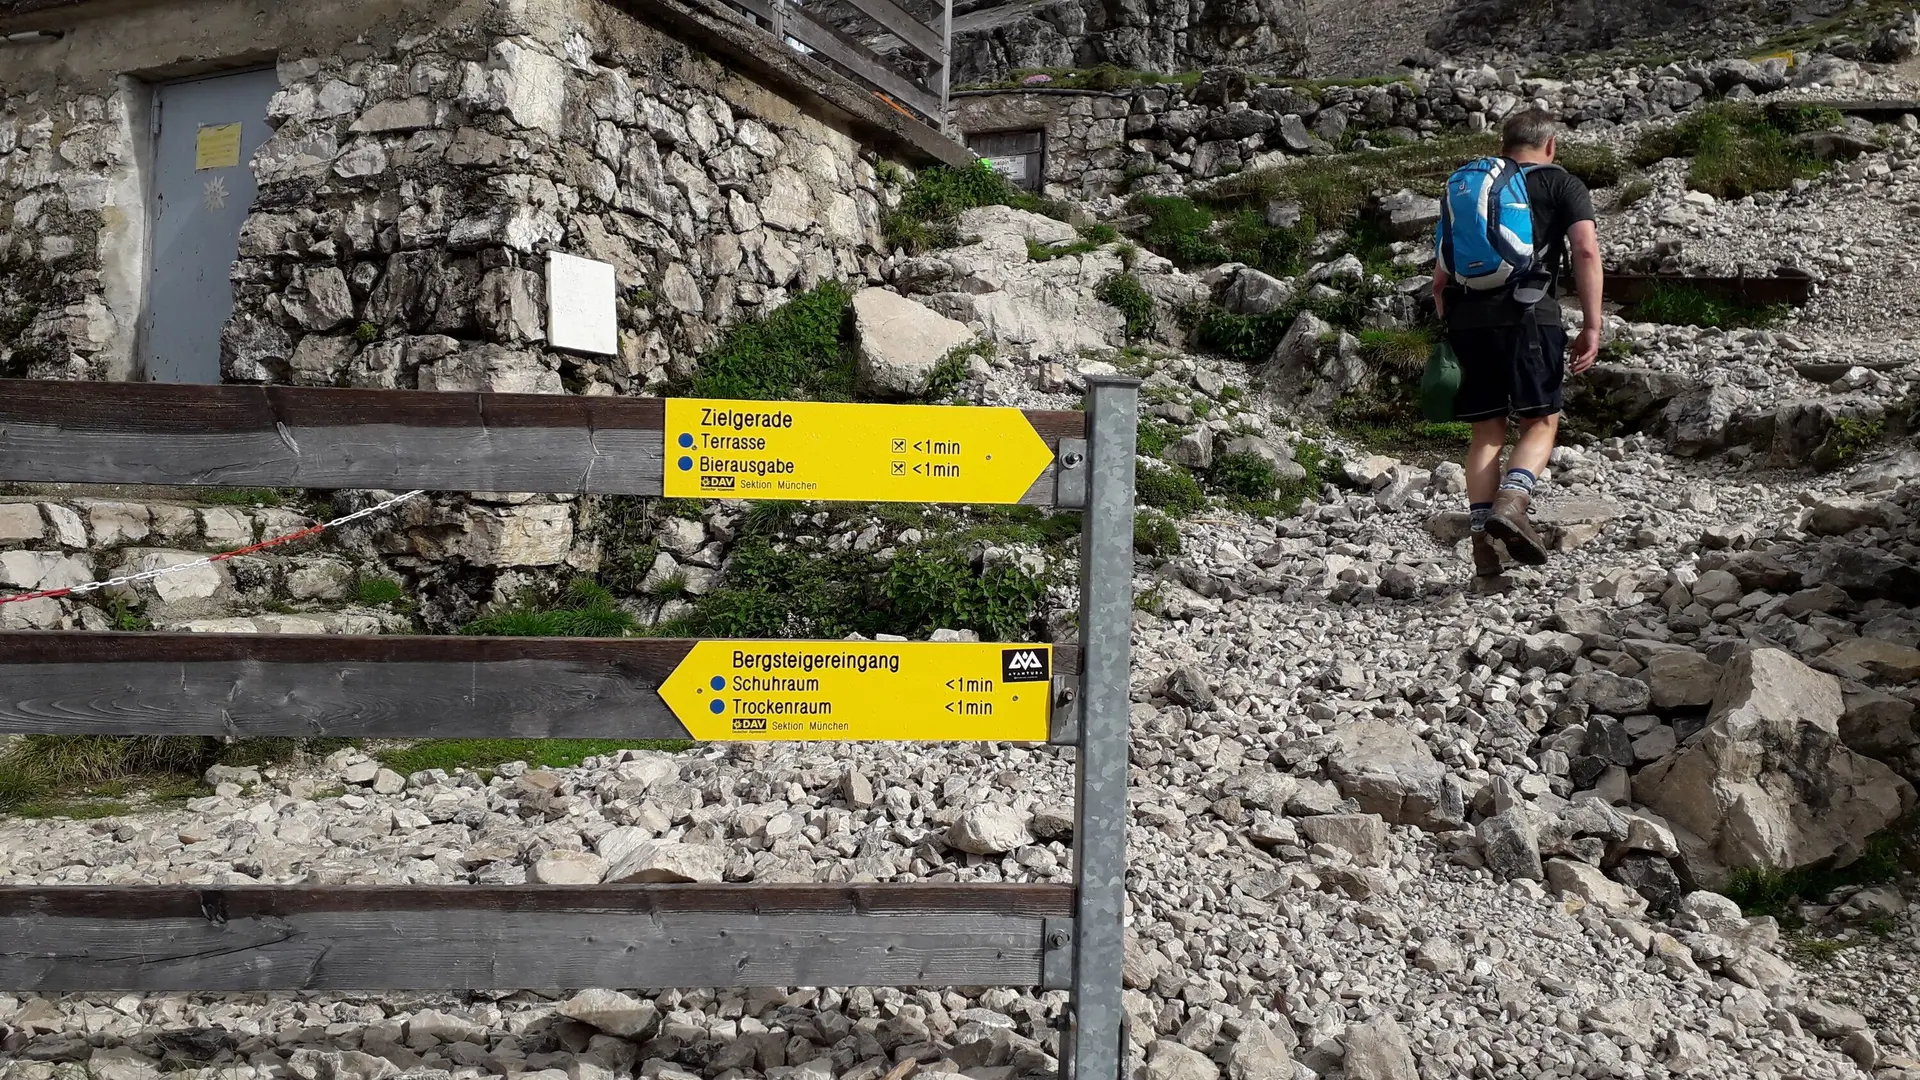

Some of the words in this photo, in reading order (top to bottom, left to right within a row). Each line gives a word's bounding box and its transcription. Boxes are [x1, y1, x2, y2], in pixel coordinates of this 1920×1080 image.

[701, 408, 793, 430] Zielgerade
[701, 433, 766, 450] Terrasse
[700, 456, 795, 476] Bierausgabe
[711, 477, 734, 486] DAV
[740, 479, 772, 489] Sektion
[777, 480, 817, 490] München
[732, 650, 900, 673] Bergsteigereingang
[732, 675, 819, 692] Schuhraum
[732, 698, 832, 715] Trockenraum
[742, 719, 766, 729] DAV
[772, 721, 804, 731] Sektion
[809, 721, 849, 731] München
